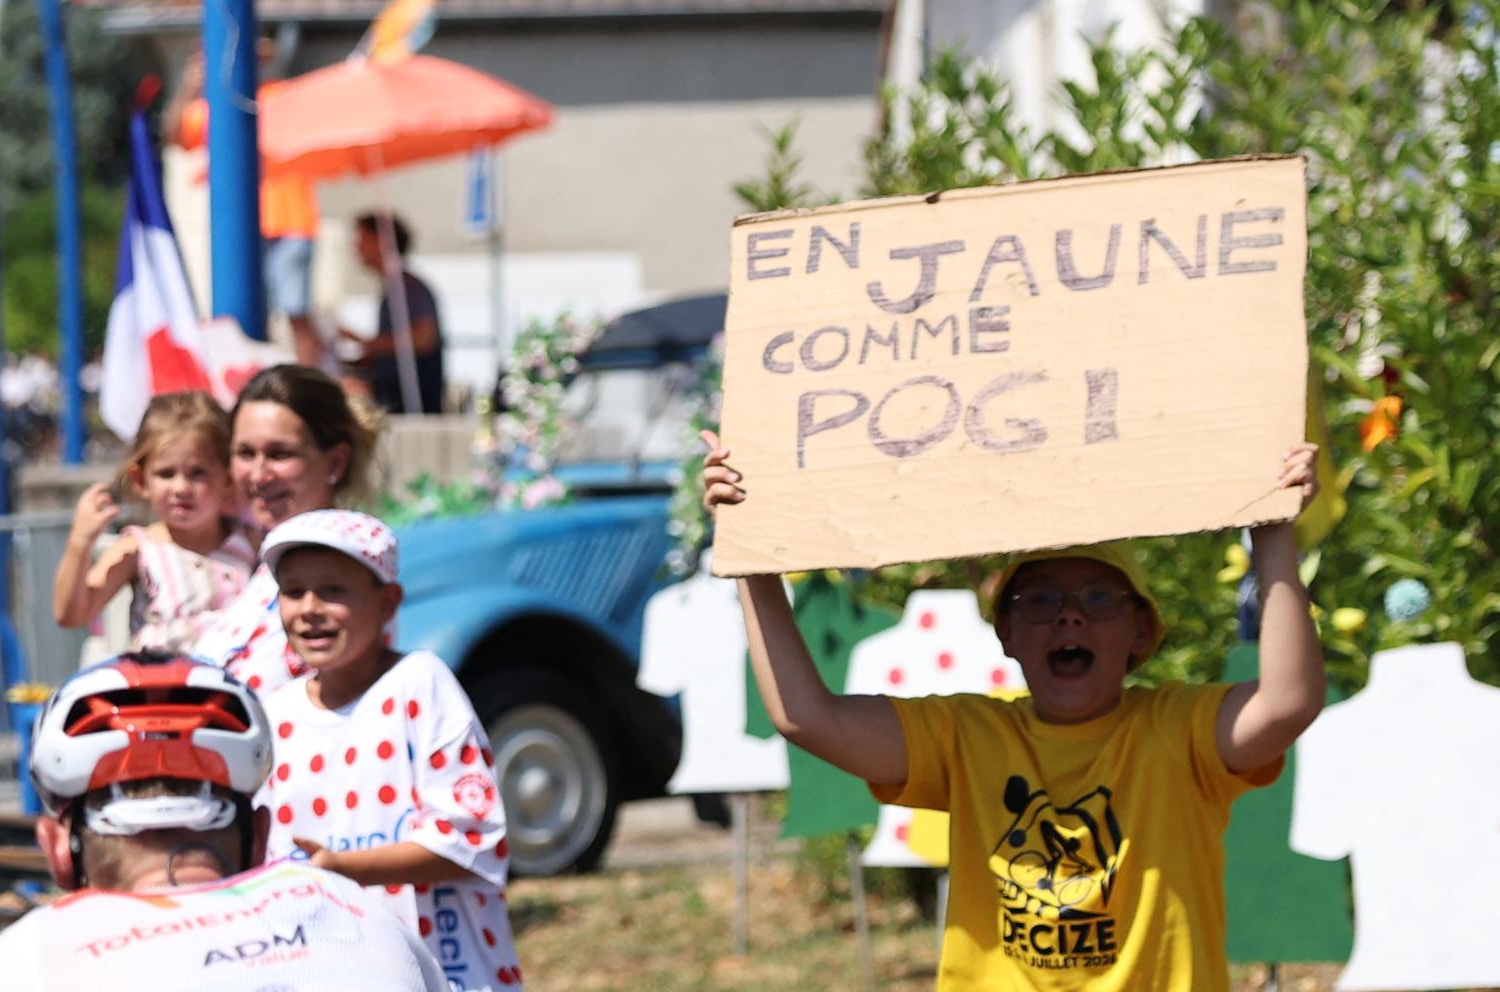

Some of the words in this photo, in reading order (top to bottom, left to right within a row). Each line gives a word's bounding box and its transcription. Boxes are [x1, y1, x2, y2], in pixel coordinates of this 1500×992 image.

[747, 222, 861, 281] EN
[867, 206, 1286, 314] JAUNE
[762, 304, 1012, 375] COMME
[205, 924, 308, 967] ADM
